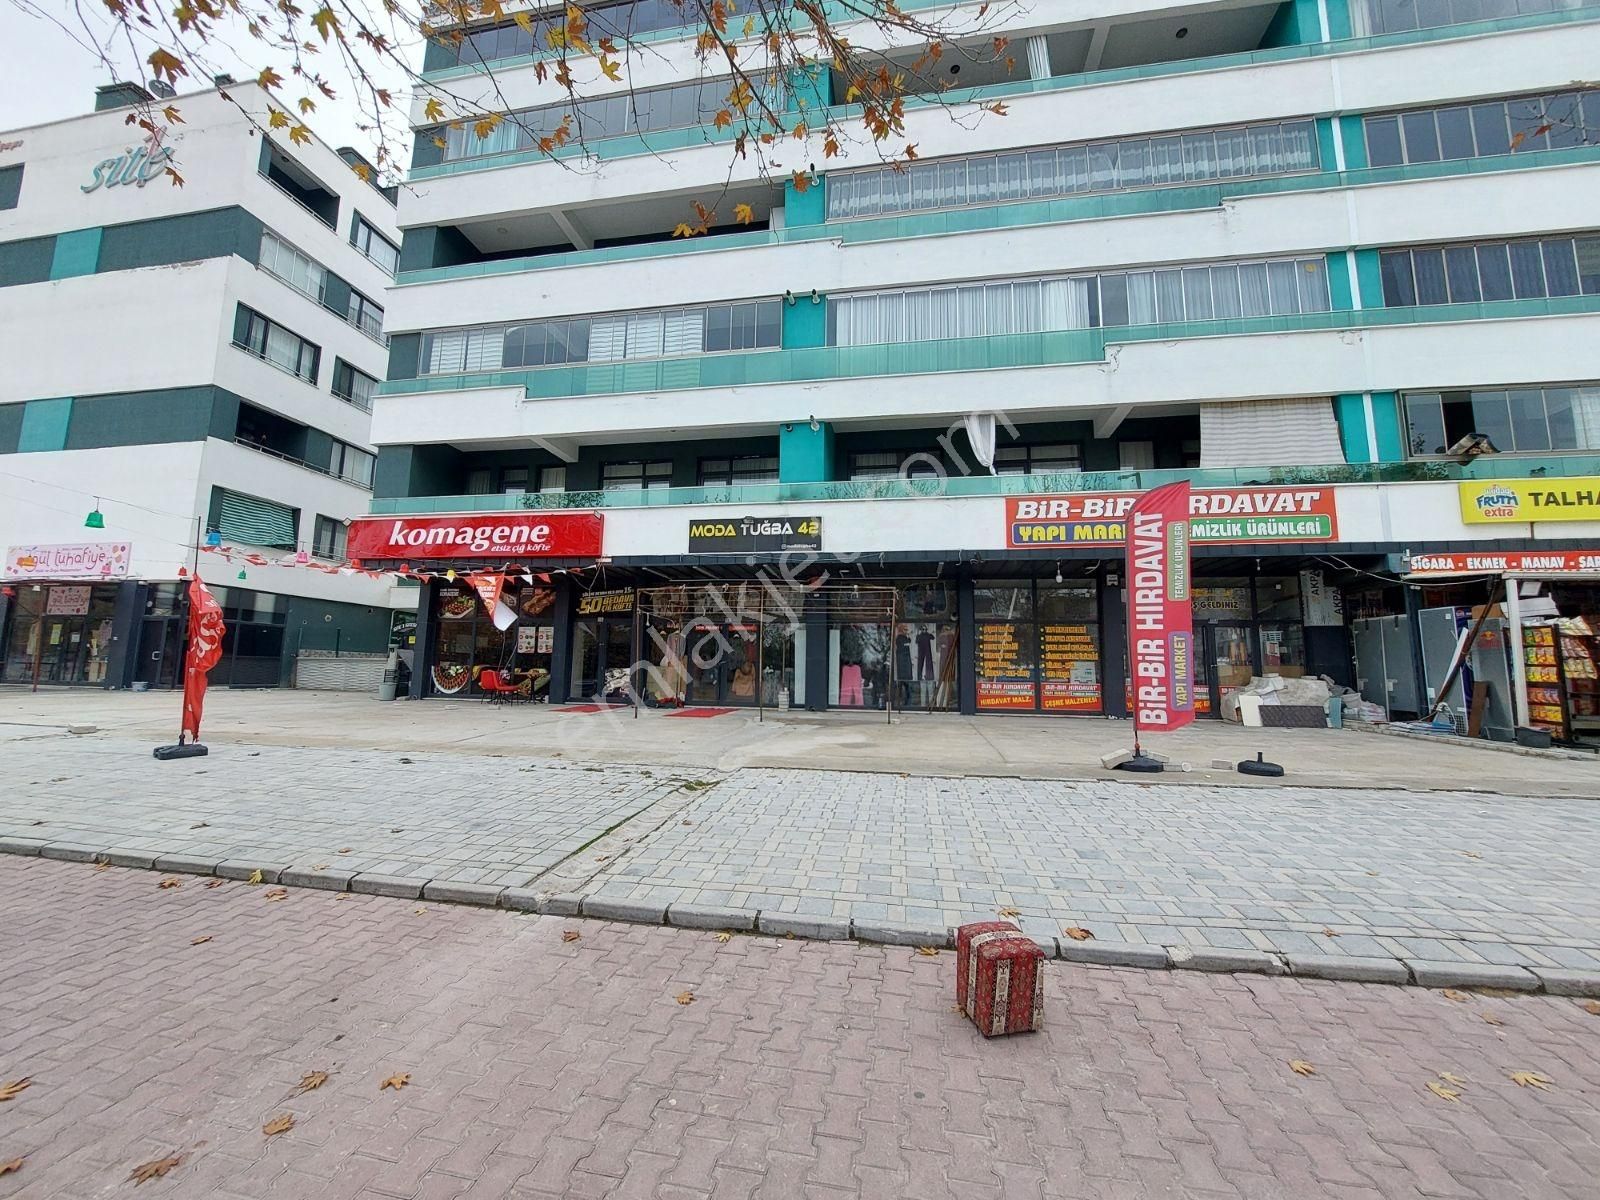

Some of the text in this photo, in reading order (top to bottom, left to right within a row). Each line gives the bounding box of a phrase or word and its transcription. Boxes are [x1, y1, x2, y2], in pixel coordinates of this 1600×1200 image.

[1189, 491, 1320, 515] RDAVAT
[1485, 508, 1513, 517] extra
[389, 521, 550, 552] komagene
[690, 520, 819, 537] MODA TUĞBA 42
[1019, 524, 1067, 542] YAPI
[1074, 522, 1126, 541] MAR
[526, 543, 551, 553] köfte
[1134, 511, 1164, 630] HIRDAVAT
[1467, 557, 1508, 569] EKMEK
[1521, 556, 1565, 569] MANAV
[1174, 635, 1187, 708] YAPI MARKET
